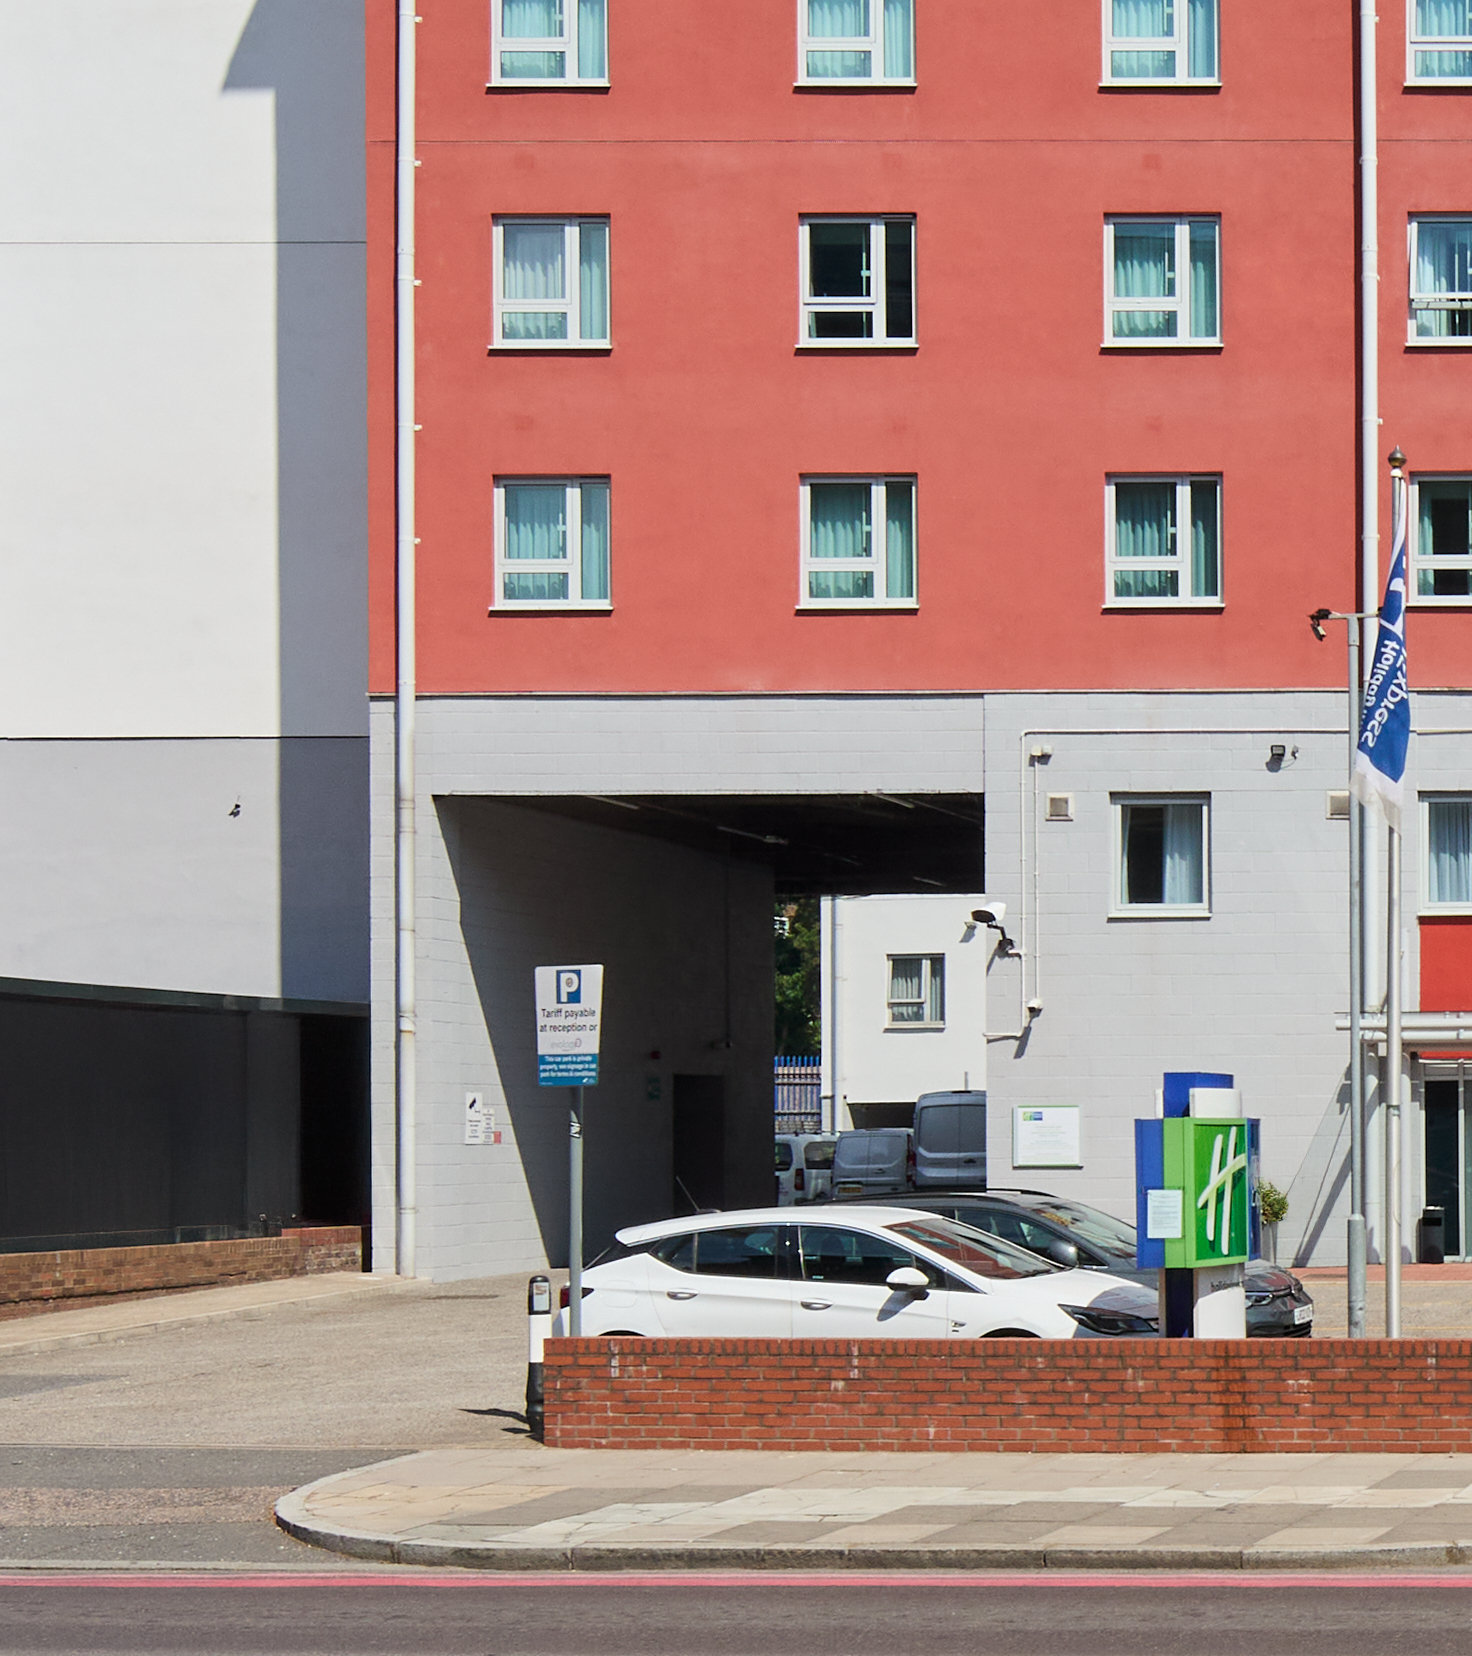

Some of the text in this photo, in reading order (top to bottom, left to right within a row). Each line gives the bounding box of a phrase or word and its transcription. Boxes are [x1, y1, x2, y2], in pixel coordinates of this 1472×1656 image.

[541, 1008, 596, 1020] Tariff payable
[539, 1023, 598, 1034] at reception or
